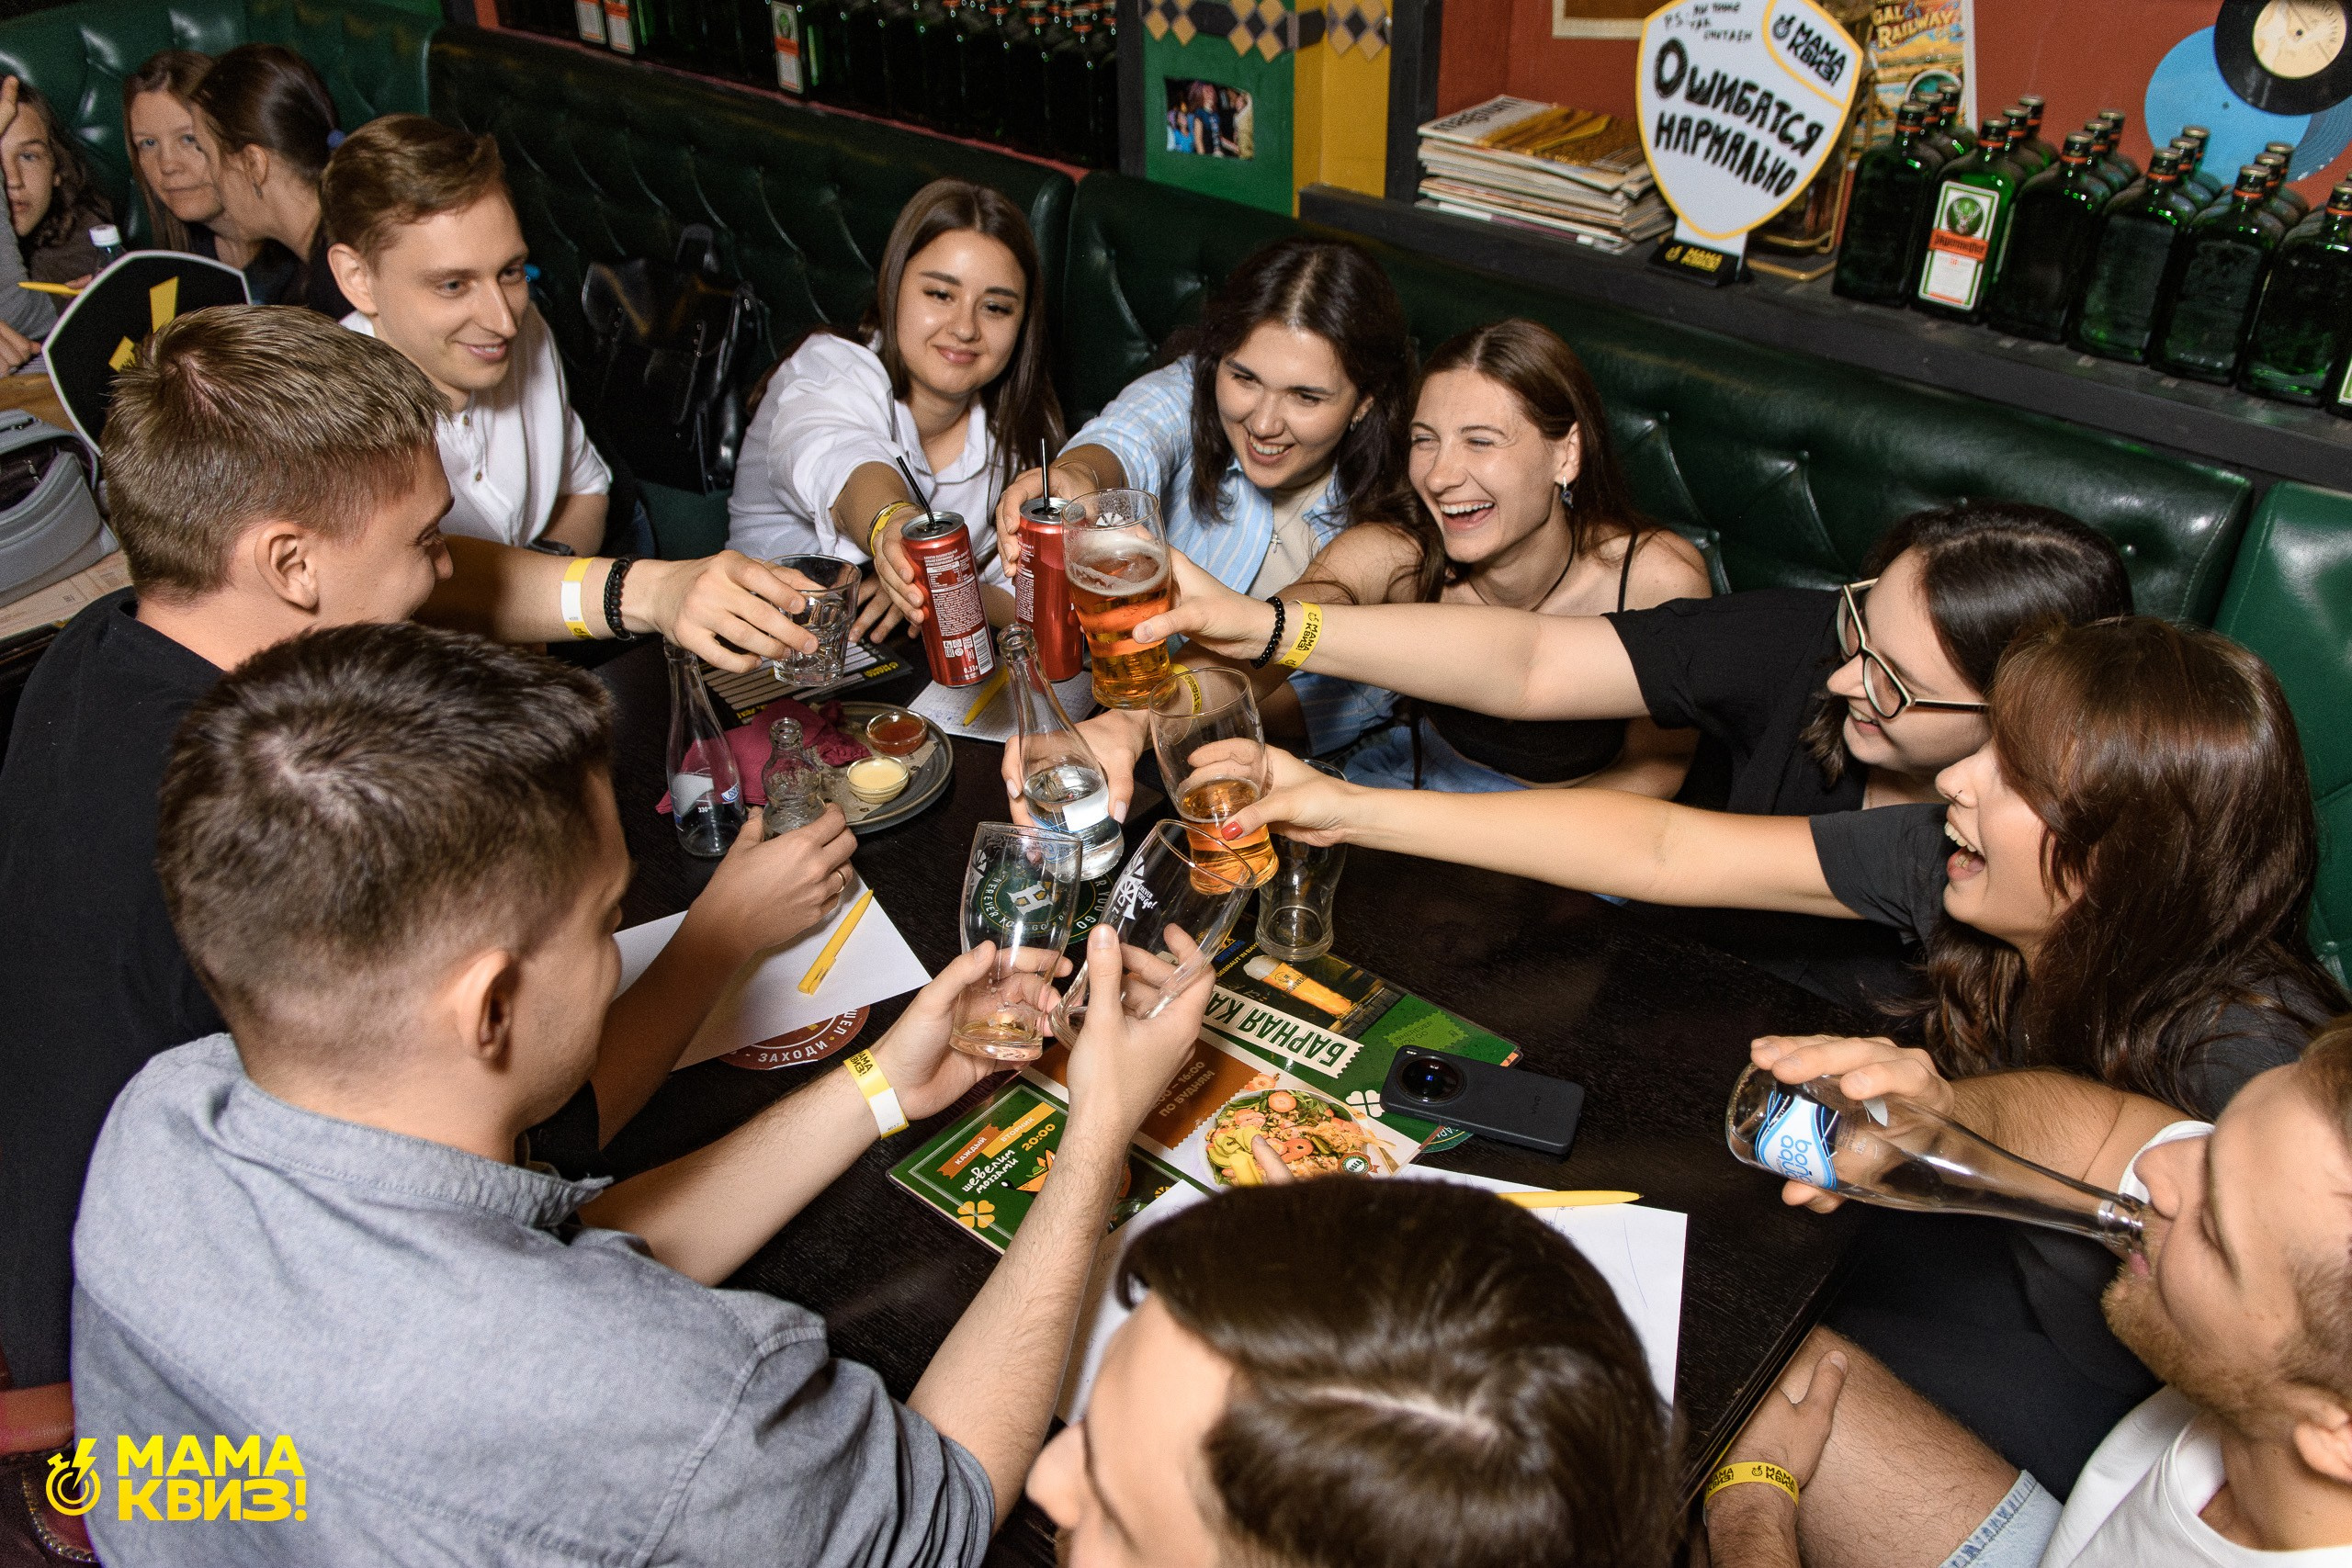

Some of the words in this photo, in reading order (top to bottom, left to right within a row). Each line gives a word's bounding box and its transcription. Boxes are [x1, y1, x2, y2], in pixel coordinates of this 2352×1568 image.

[1795, 21, 1847, 70] МАМА
[1876, 10, 1953, 50] RAILWAY
[1787, 38, 1838, 86] КВИЗ!
[1655, 111, 1798, 198] НАРМАЛЬНО
[1296, 622, 1312, 651] КВИЗ!
[1303, 624, 1318, 651] МАМА
[757, 1040, 829, 1063] ЗАХОДИ
[1237, 1007, 1349, 1067] БАРНАЯ
[849, 1055, 867, 1077] ВИЗ!
[1177, 1061, 1205, 1083] 16:00
[1158, 1102, 1176, 1117] ПО
[1173, 1069, 1216, 1104] БУДНЯМ
[955, 1136, 988, 1166] КАЖДЫЙ
[1000, 1116, 1035, 1143] ВТОРНИК
[1021, 1122, 1056, 1152] 20:00
